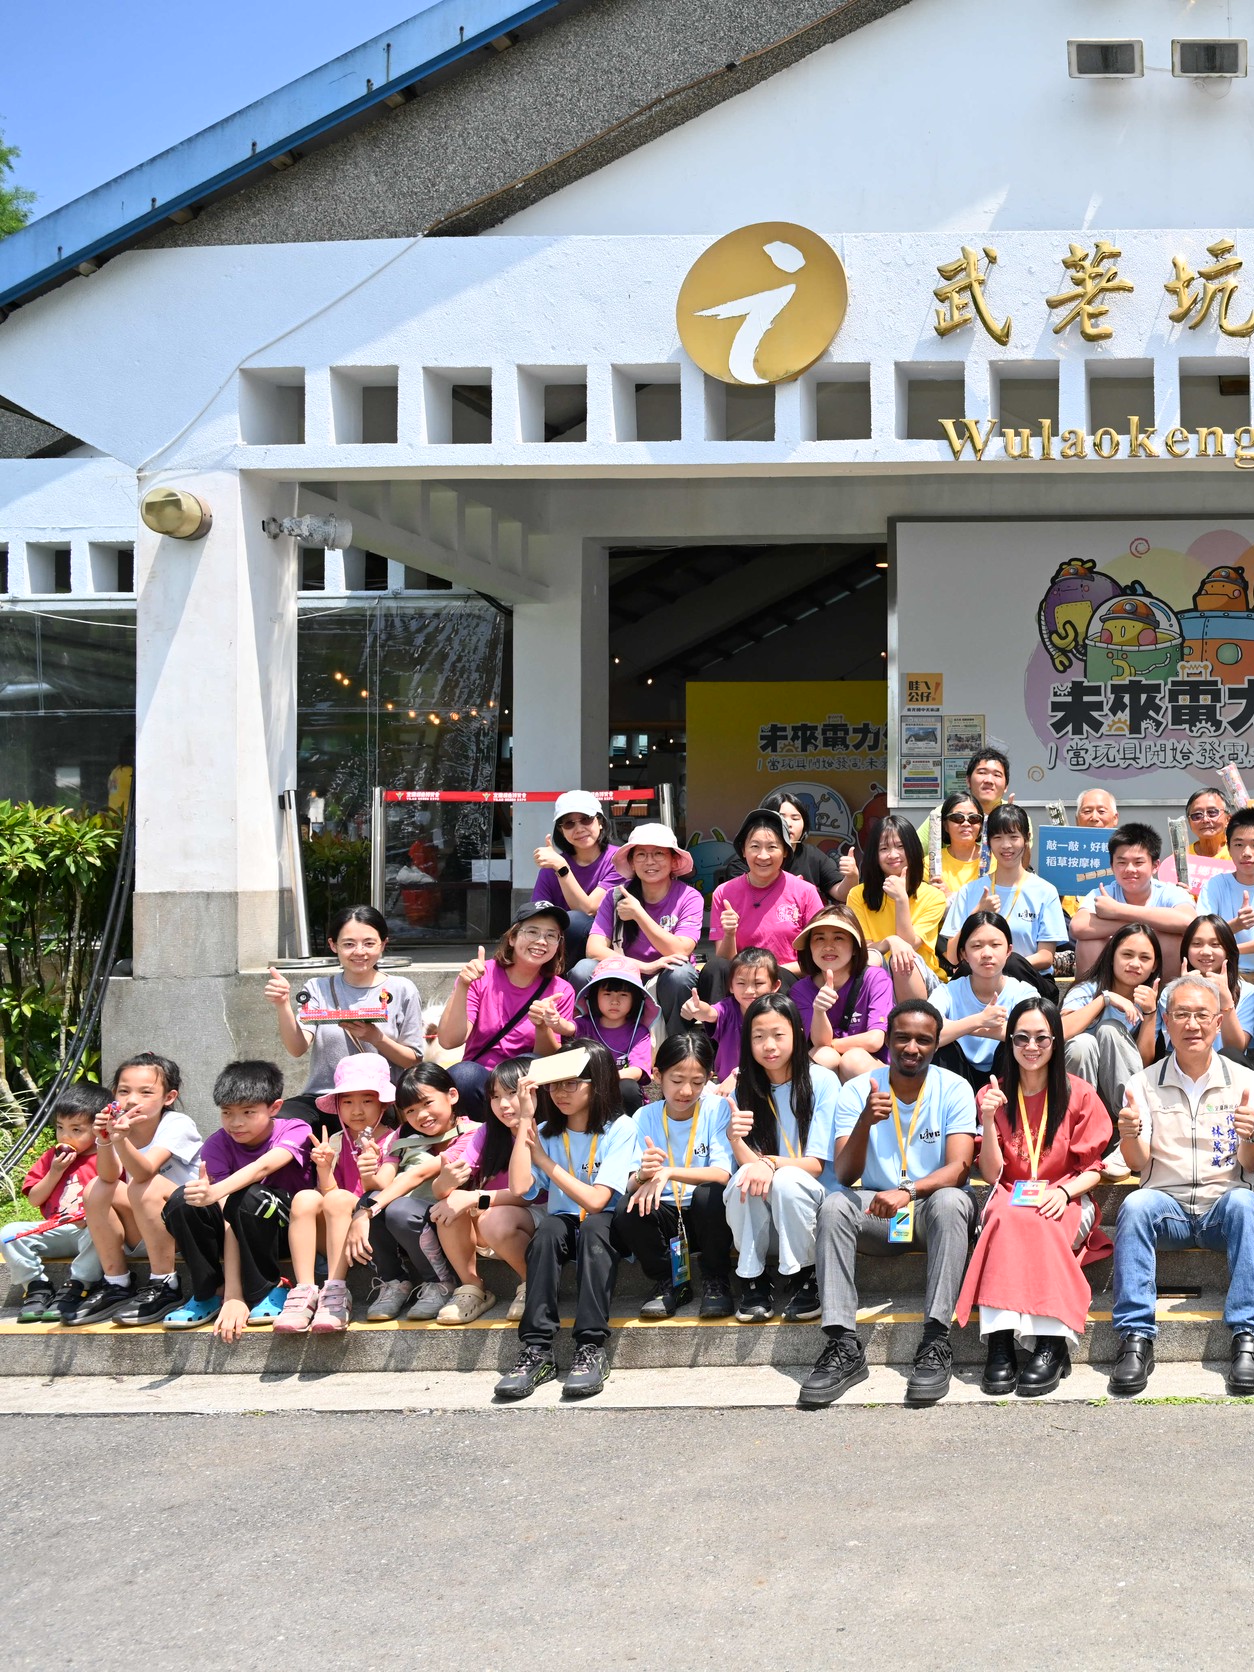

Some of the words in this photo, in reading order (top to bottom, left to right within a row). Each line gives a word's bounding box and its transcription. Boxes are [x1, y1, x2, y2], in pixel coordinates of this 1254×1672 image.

[760, 722, 888, 753] 未來電力
[1046, 856, 1101, 869] 稻草按摩棒
[1211, 1125, 1224, 1168] 林茂盛
